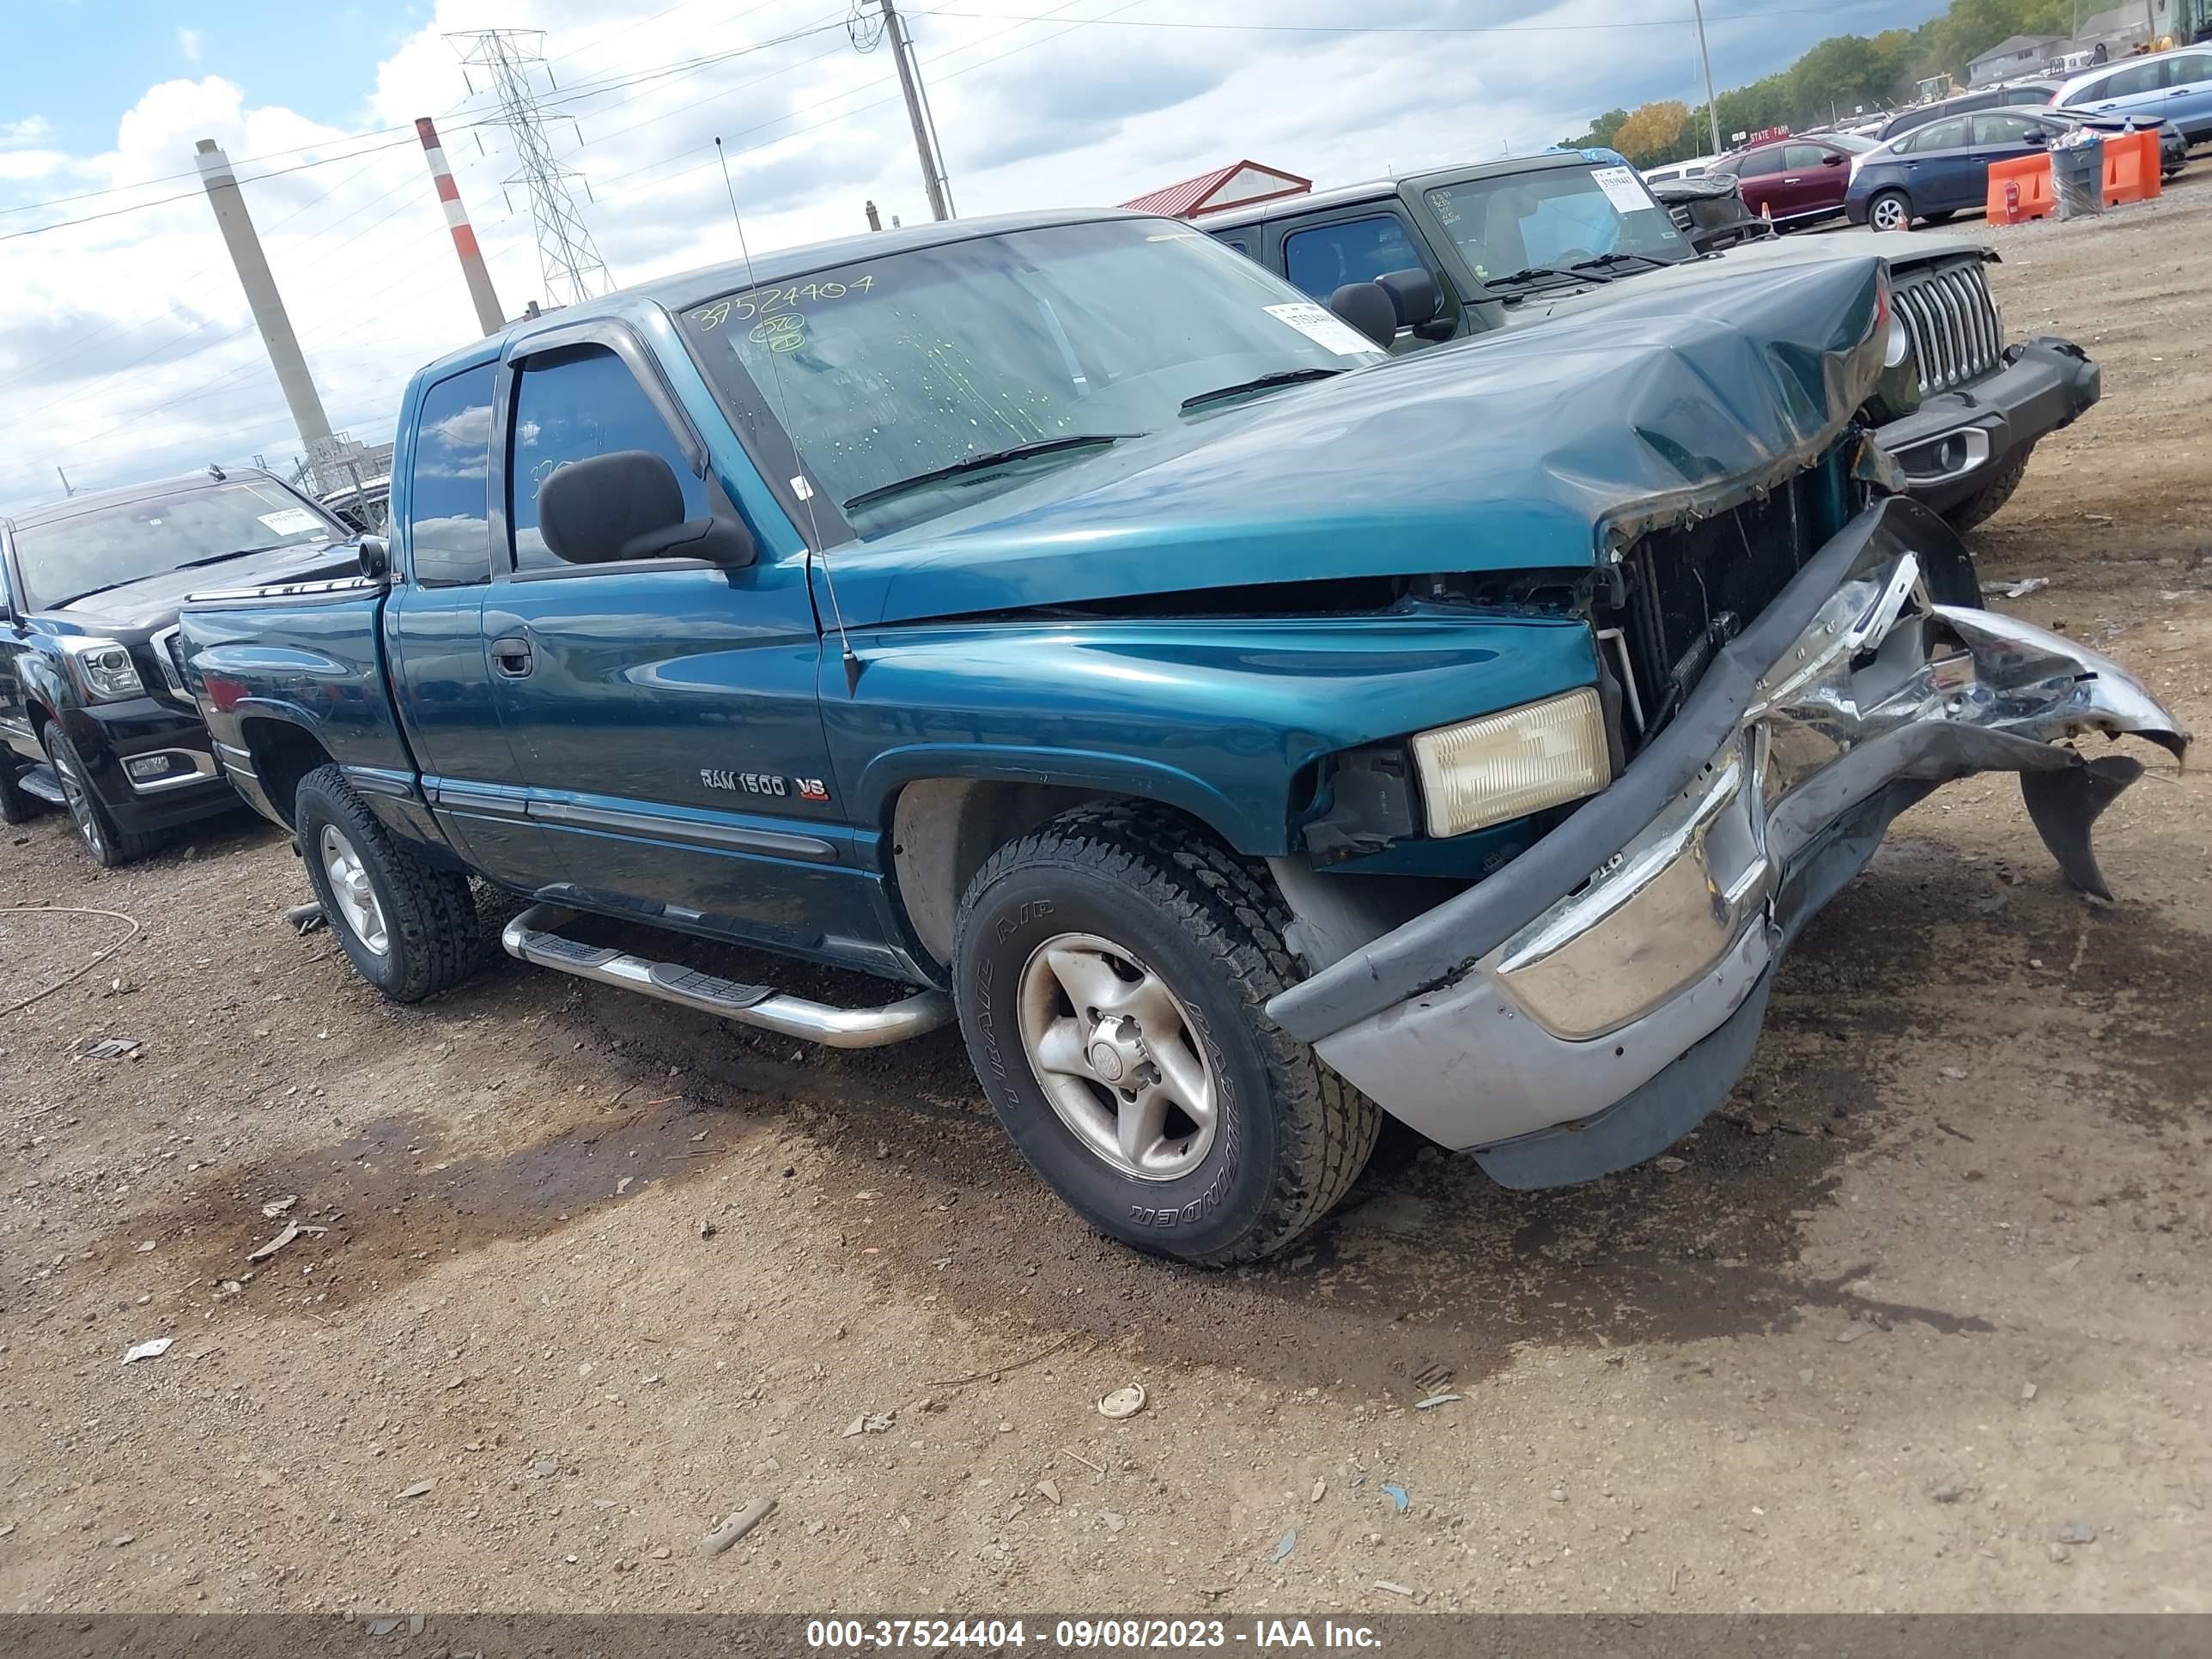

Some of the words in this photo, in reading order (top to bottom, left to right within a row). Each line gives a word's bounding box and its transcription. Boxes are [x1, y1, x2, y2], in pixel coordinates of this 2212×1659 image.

[1750, 130, 1770, 143] STATE
[690, 275, 876, 331] 37524404
[700, 769, 737, 791] RAM
[736, 772, 786, 797] 1500
[794, 777, 825, 795] V8
[975, 959, 1020, 1109] TRAIL
[1129, 1000, 1239, 1228] PATHFINDER
